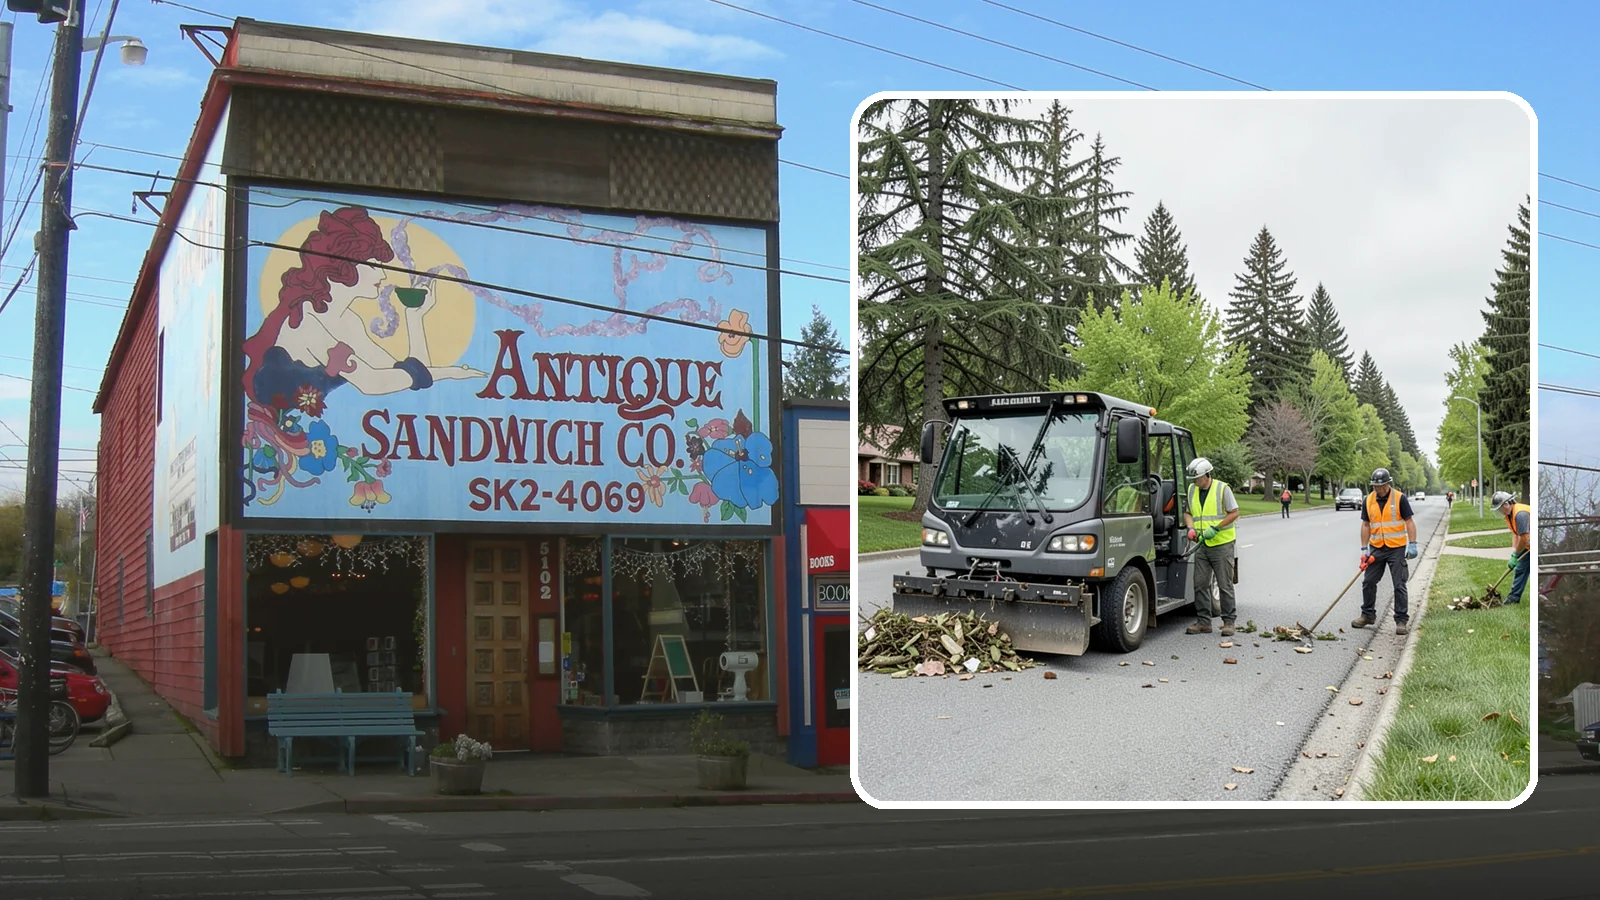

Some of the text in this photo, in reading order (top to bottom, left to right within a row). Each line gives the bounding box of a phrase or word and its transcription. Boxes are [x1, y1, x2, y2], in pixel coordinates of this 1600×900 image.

[476, 329, 724, 421] ANTIQUE
[362, 409, 686, 469] SANDWICH CO.
[469, 477, 646, 513] SK2-4069
[540, 541, 552, 600] 5102
[809, 555, 835, 569] BOOKS
